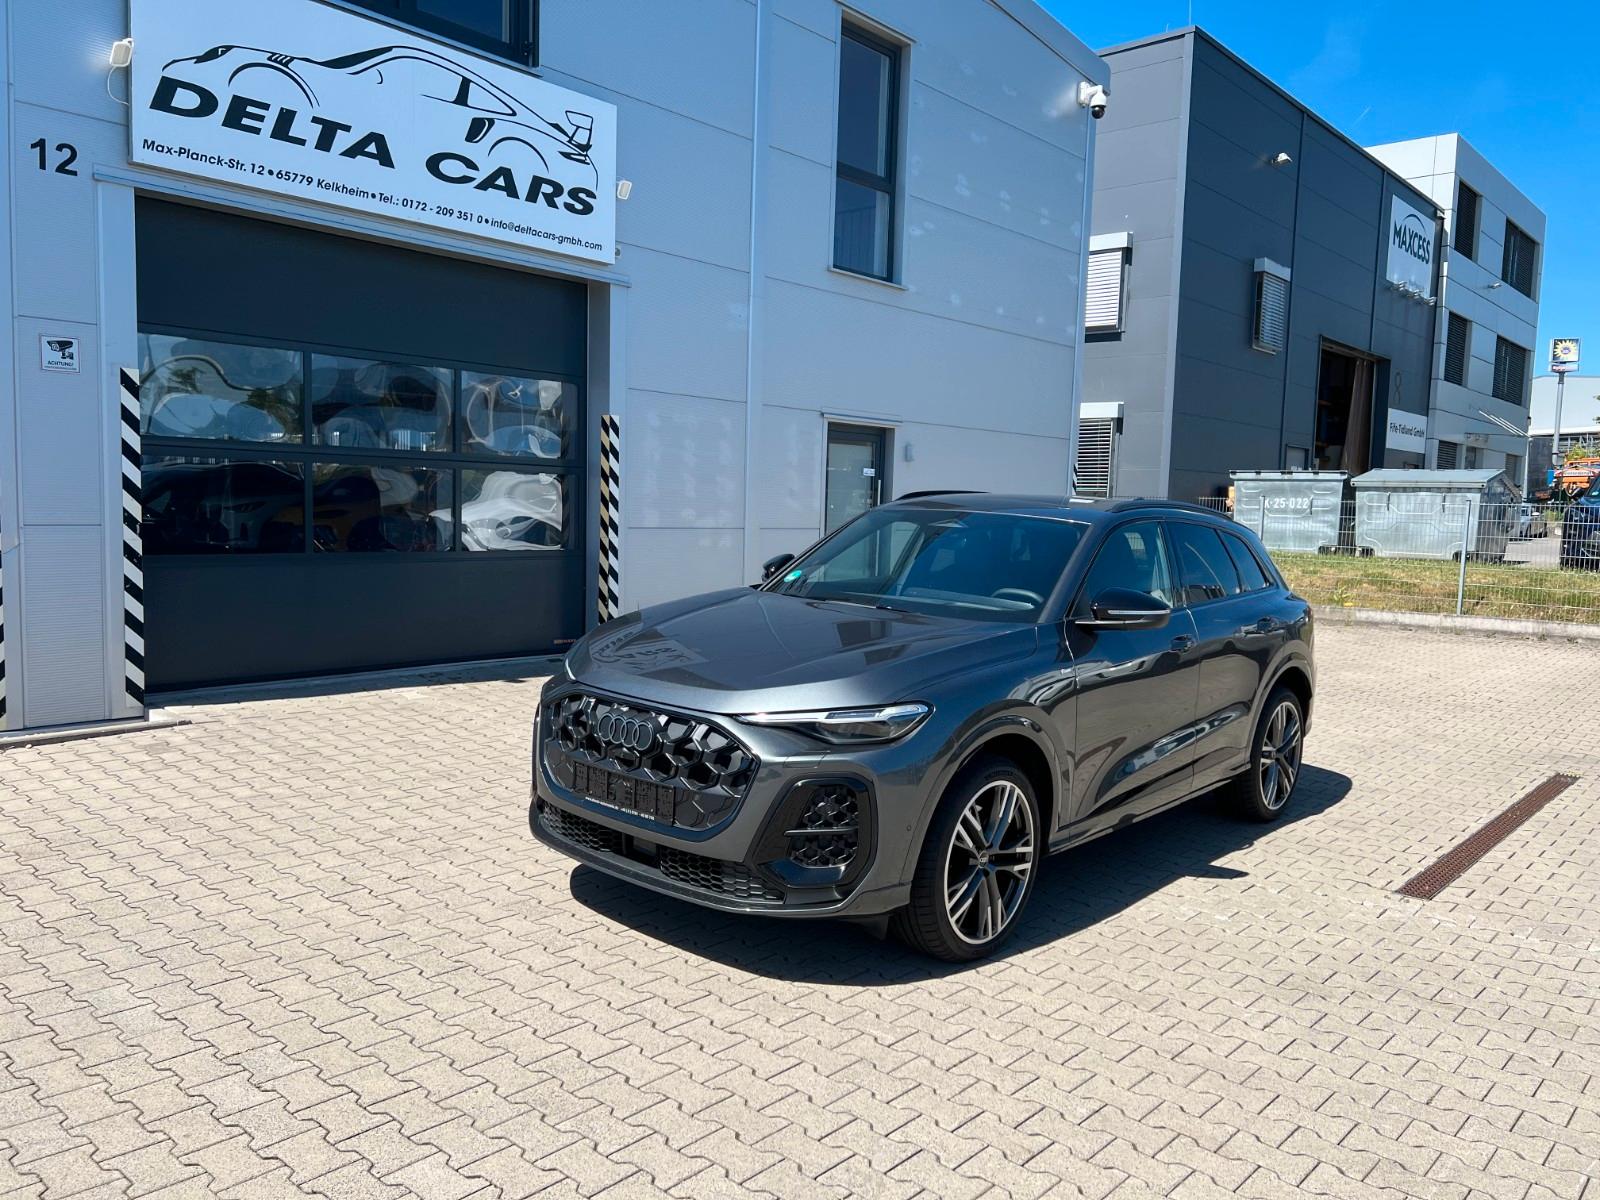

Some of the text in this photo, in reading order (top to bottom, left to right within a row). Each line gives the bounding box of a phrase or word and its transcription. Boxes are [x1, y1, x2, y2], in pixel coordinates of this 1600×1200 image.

[30, 137, 78, 177] 12
[149, 75, 597, 216] DELTA CARS
[142, 138, 247, 172] Max-Planck-Str.
[250, 163, 265, 176] 12
[276, 169, 314, 186] 65779
[316, 178, 369, 199] Kelkheim
[378, 192, 400, 206] Tel.:
[401, 198, 428, 212] 0172
[435, 205, 455, 218] 209
[456, 210, 474, 222] 351
[476, 215, 484, 225] 0
[490, 218, 603, 251] info@deltacars-gmbh.com
[1393, 220, 1431, 265] MAXCESS
